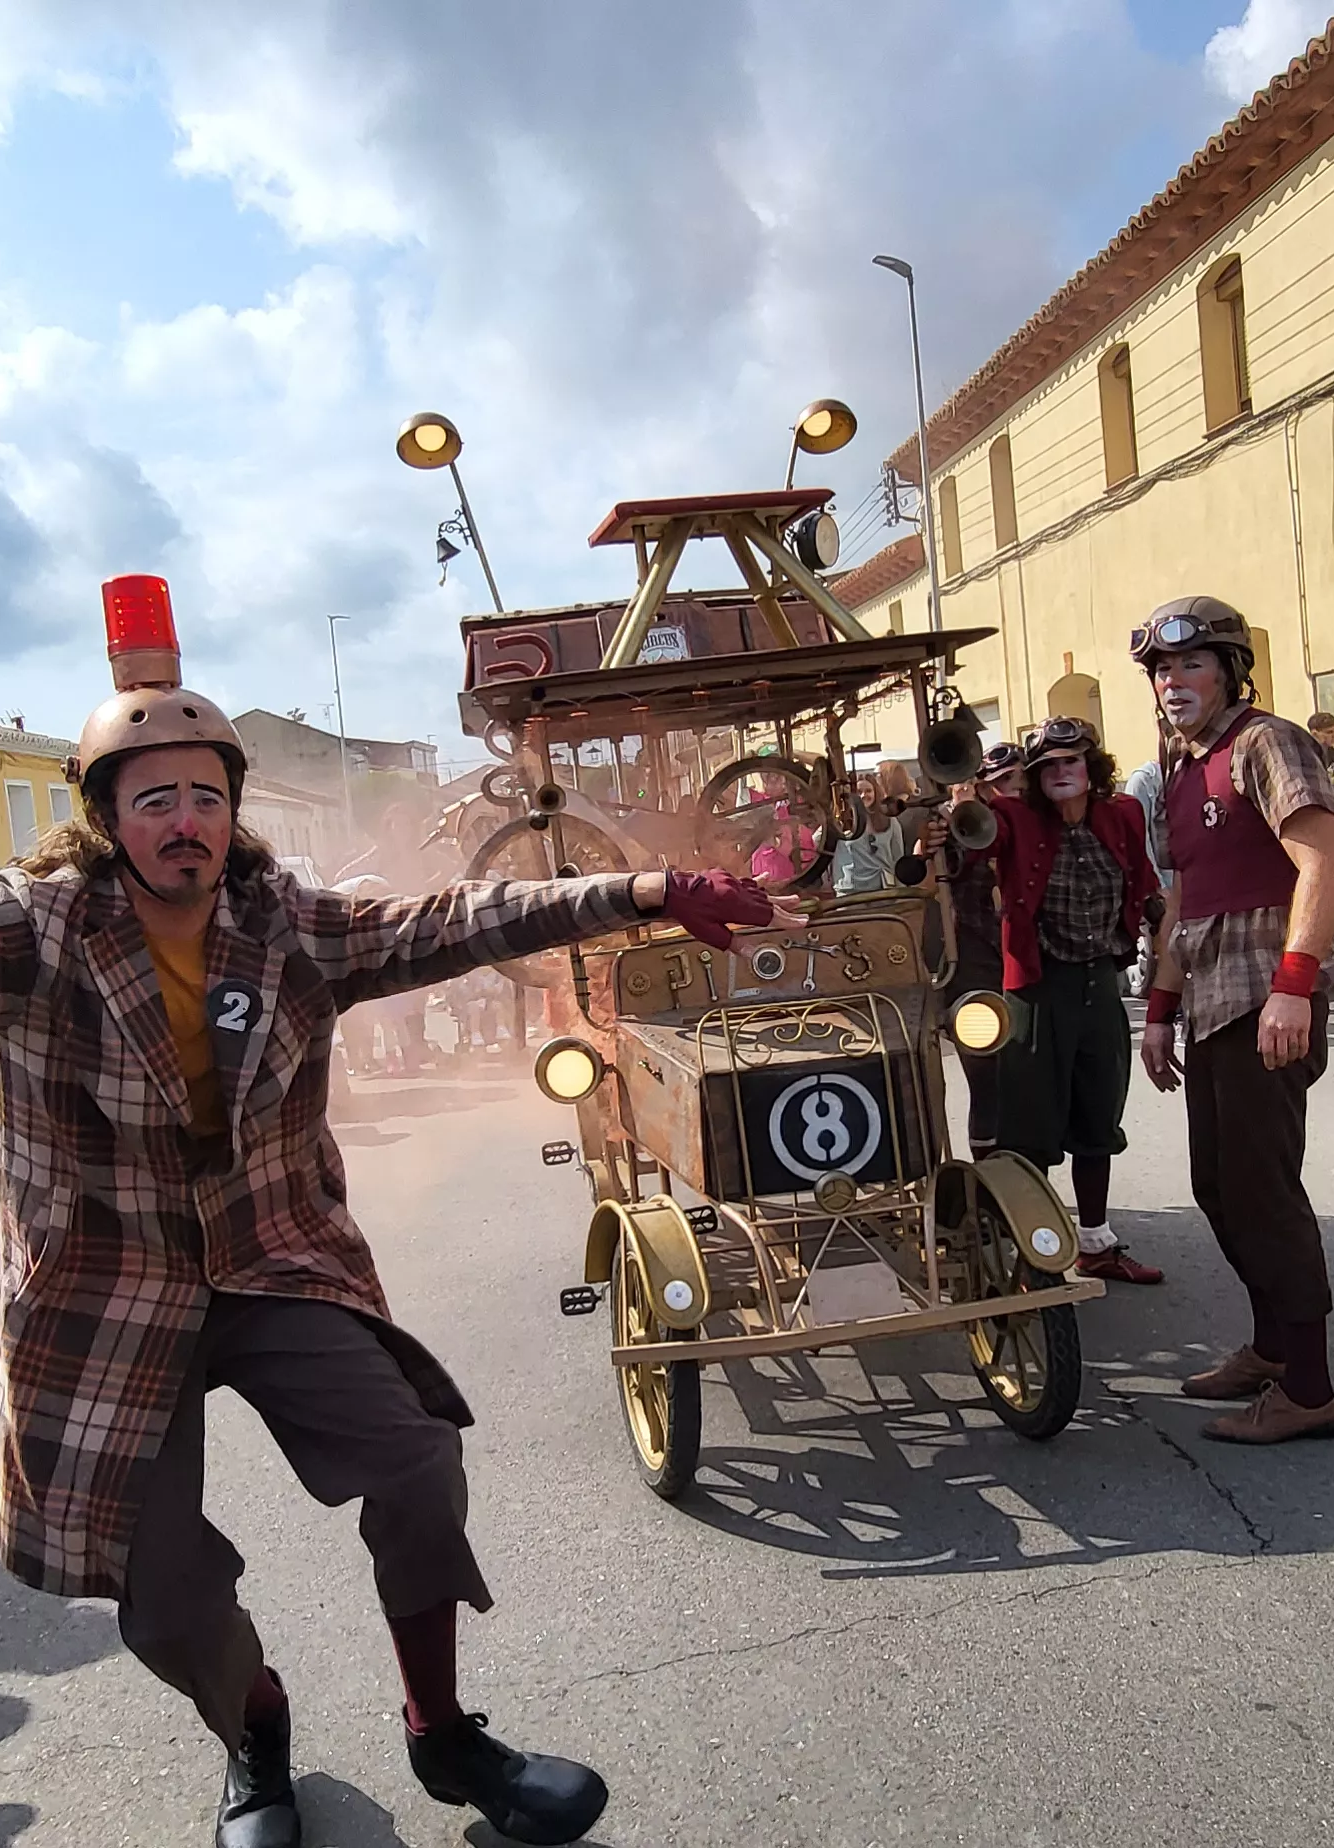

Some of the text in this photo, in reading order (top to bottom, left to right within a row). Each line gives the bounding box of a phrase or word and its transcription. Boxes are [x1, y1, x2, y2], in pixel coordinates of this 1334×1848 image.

[1203, 800, 1218, 827] 3
[215, 991, 251, 1032] 2
[800, 1089, 852, 1163] 8
